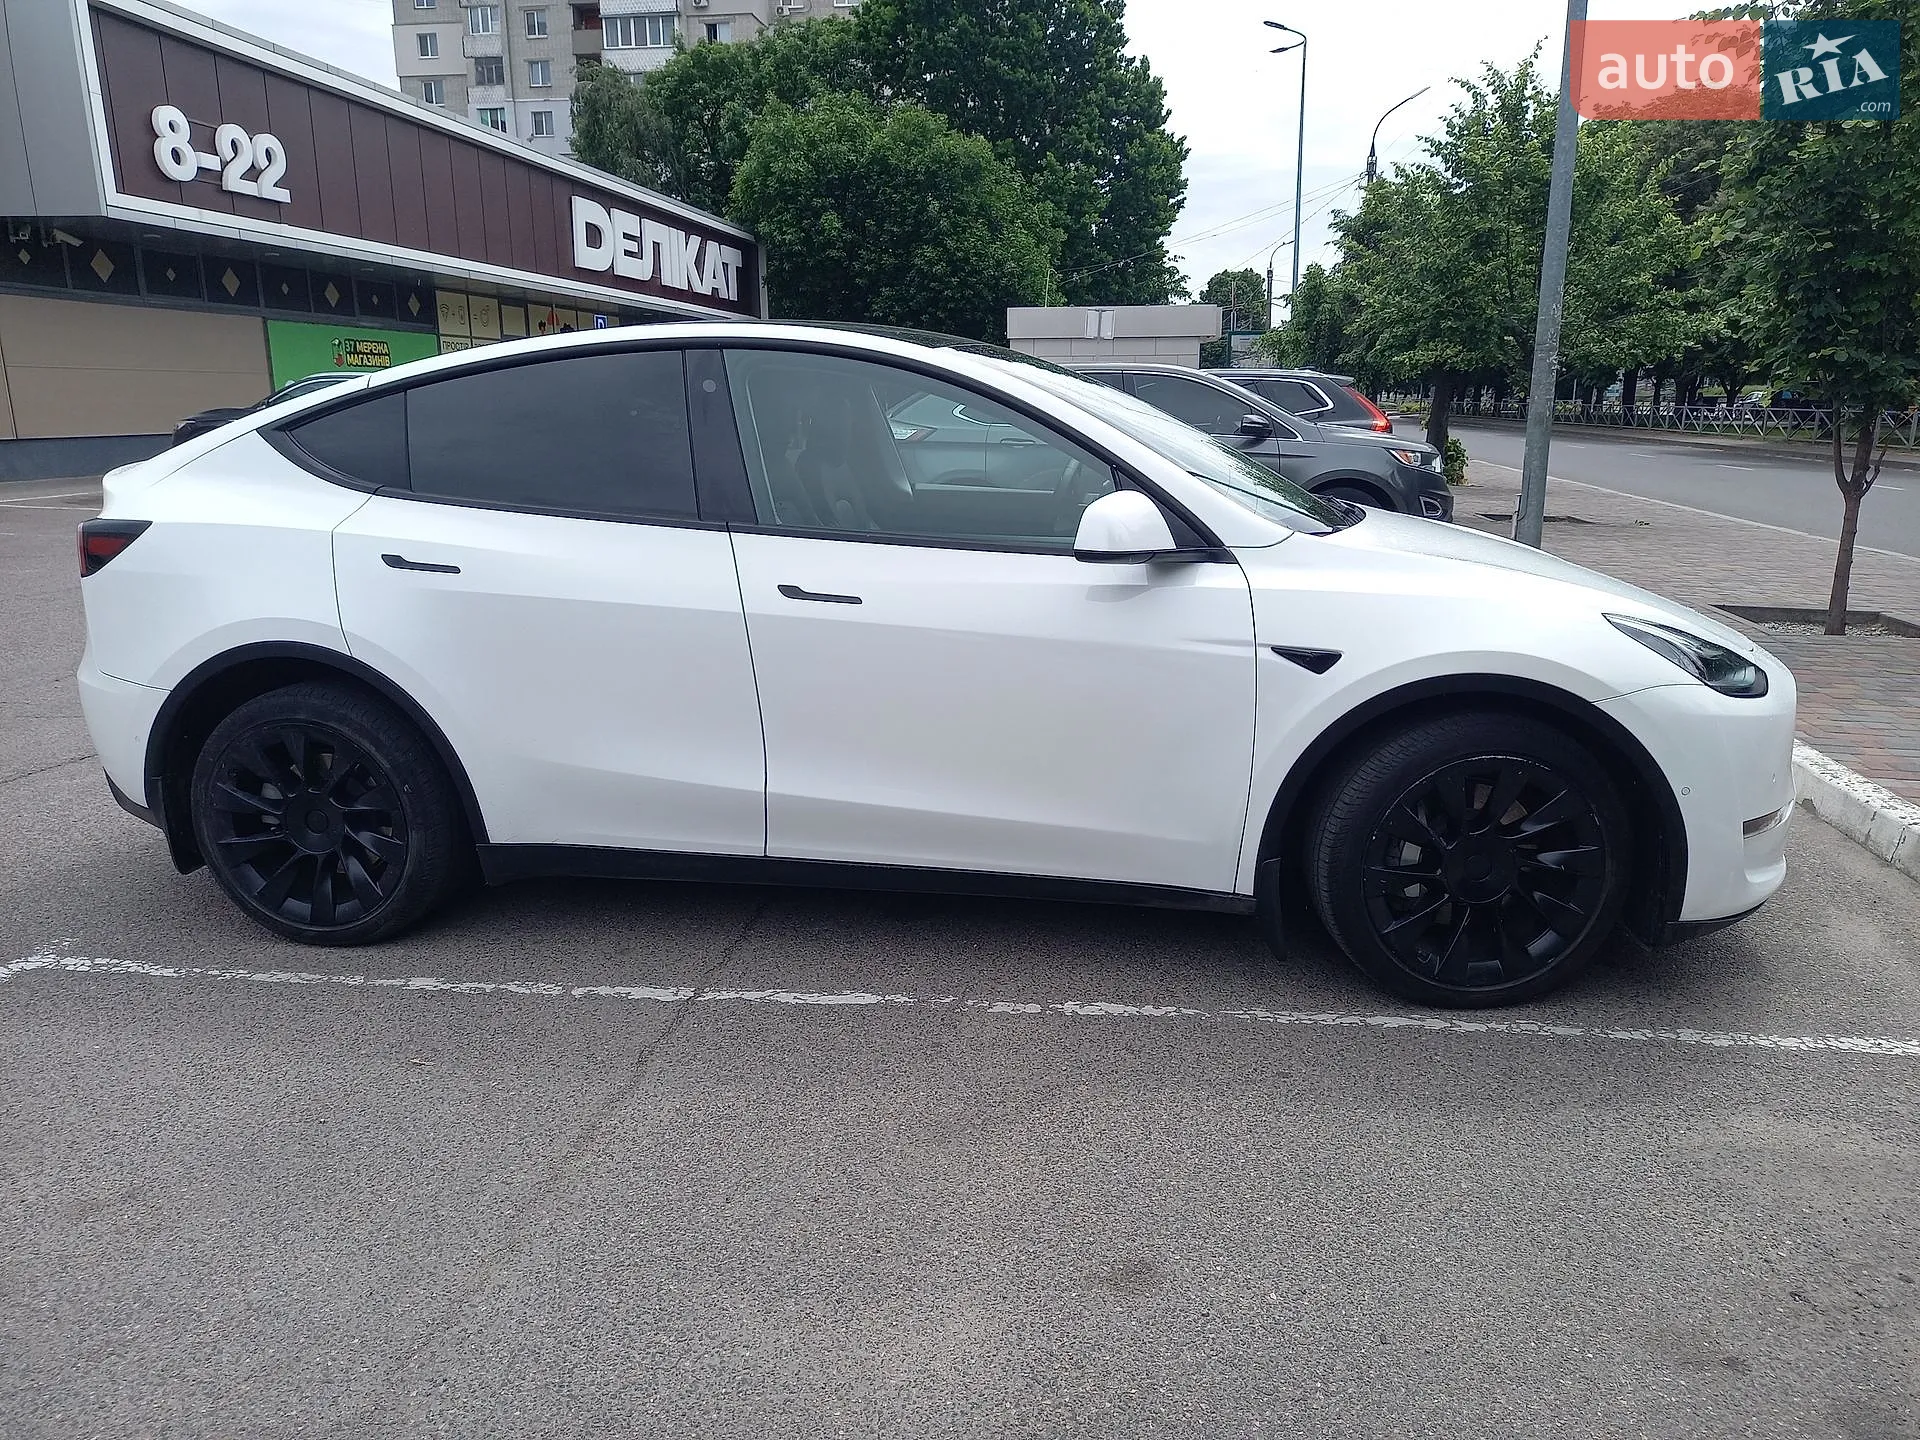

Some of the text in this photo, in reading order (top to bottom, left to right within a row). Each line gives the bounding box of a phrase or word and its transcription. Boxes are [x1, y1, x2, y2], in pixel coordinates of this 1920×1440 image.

[151, 105, 292, 204] 8-22
[345, 340, 389, 354] 37 МЕРЕЖА
[346, 353, 390, 367] МАГАЗИНІВ
